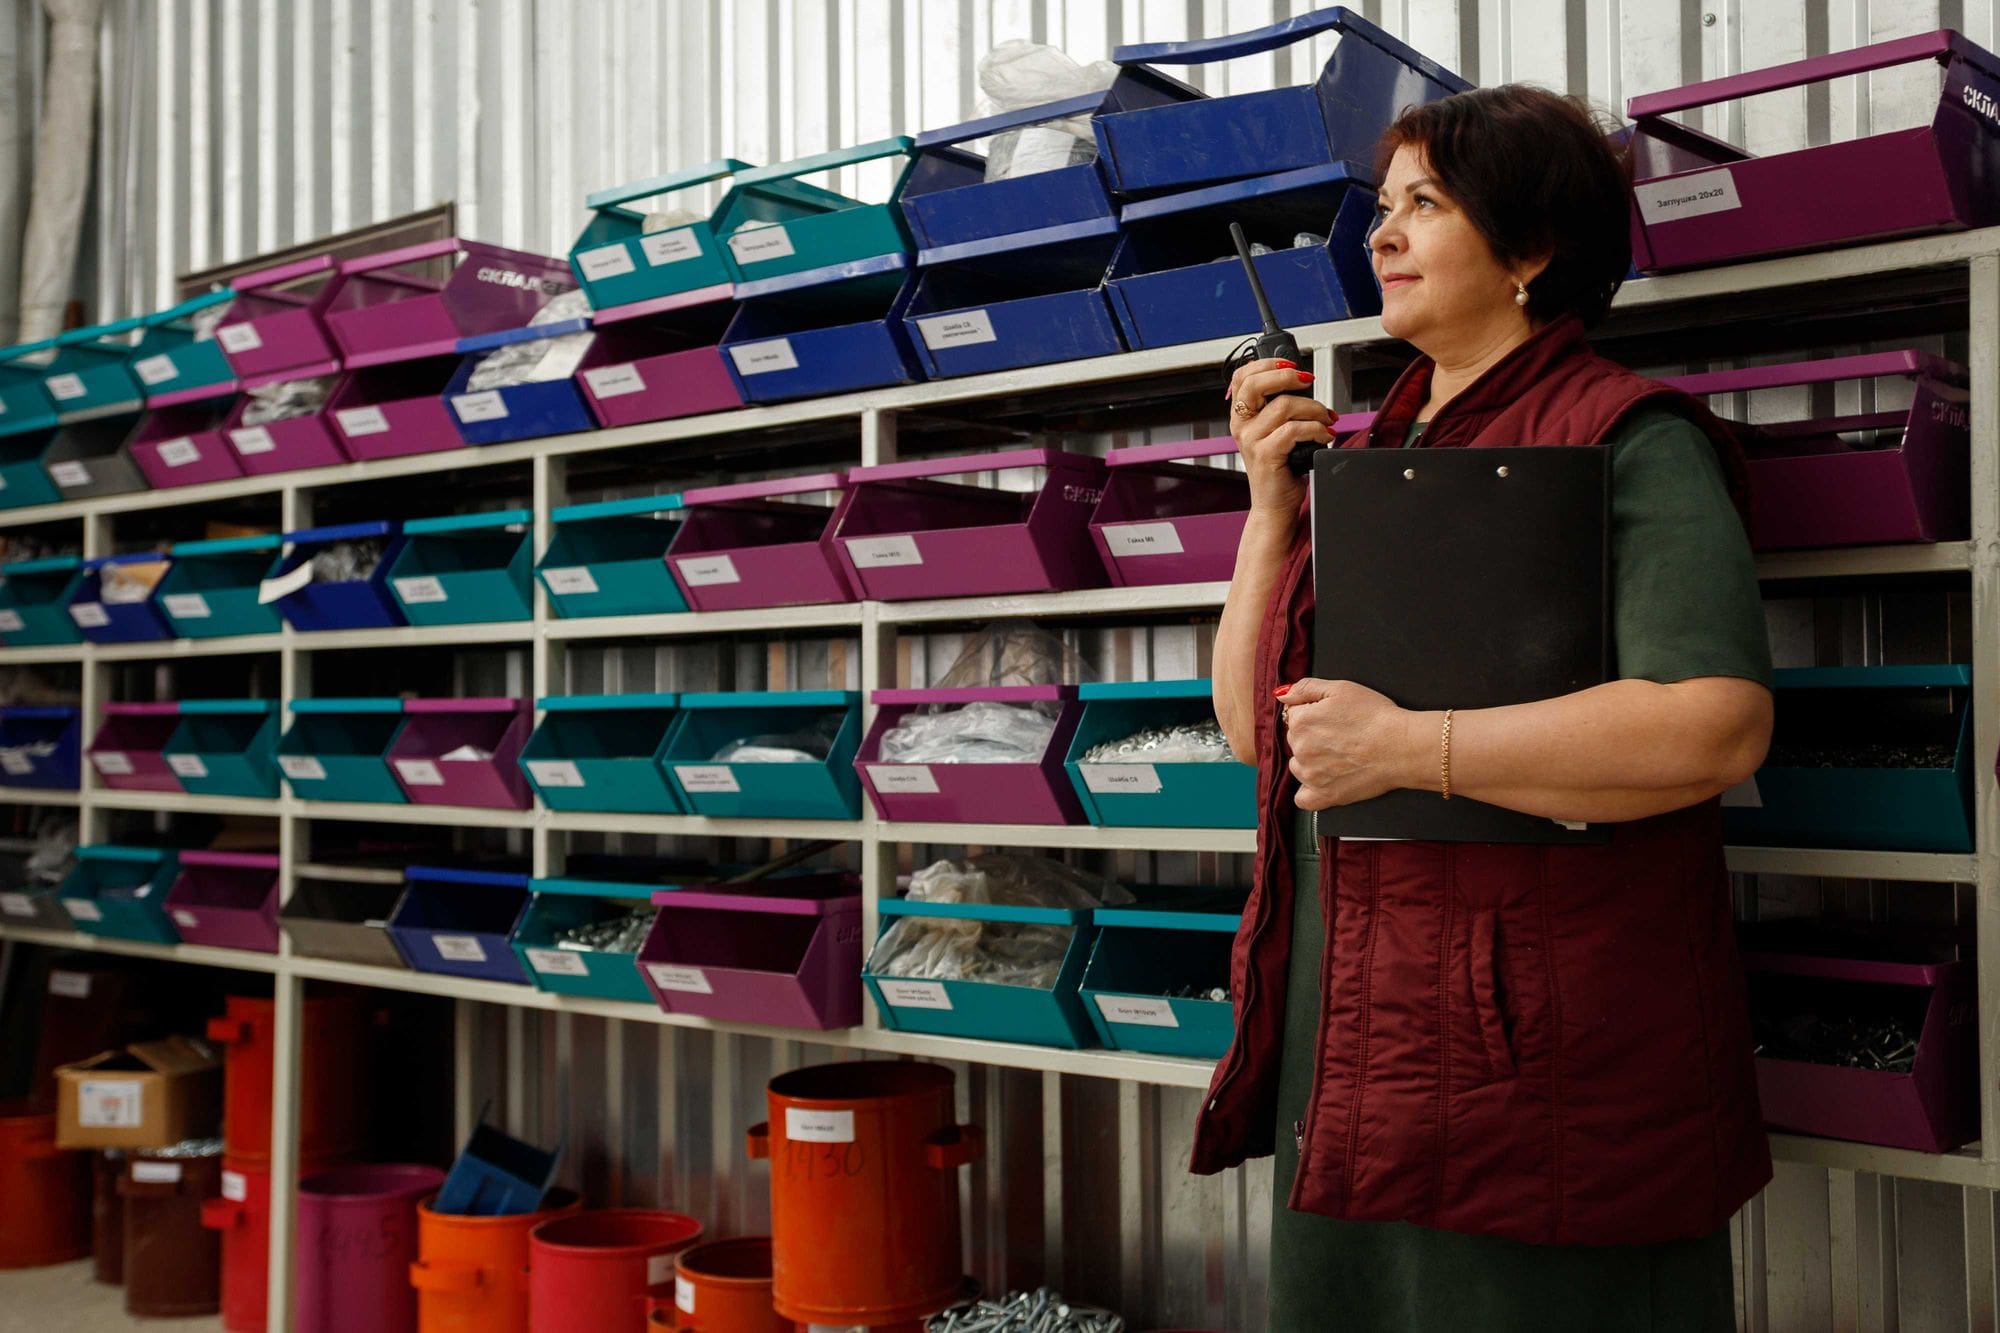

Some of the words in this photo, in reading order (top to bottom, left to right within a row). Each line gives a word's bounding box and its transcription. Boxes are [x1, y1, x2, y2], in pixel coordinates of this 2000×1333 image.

[1963, 84, 2000, 126] СКЛА
[1656, 193, 1698, 209] Заглушка
[1931, 401, 1970, 431] СКЛА
